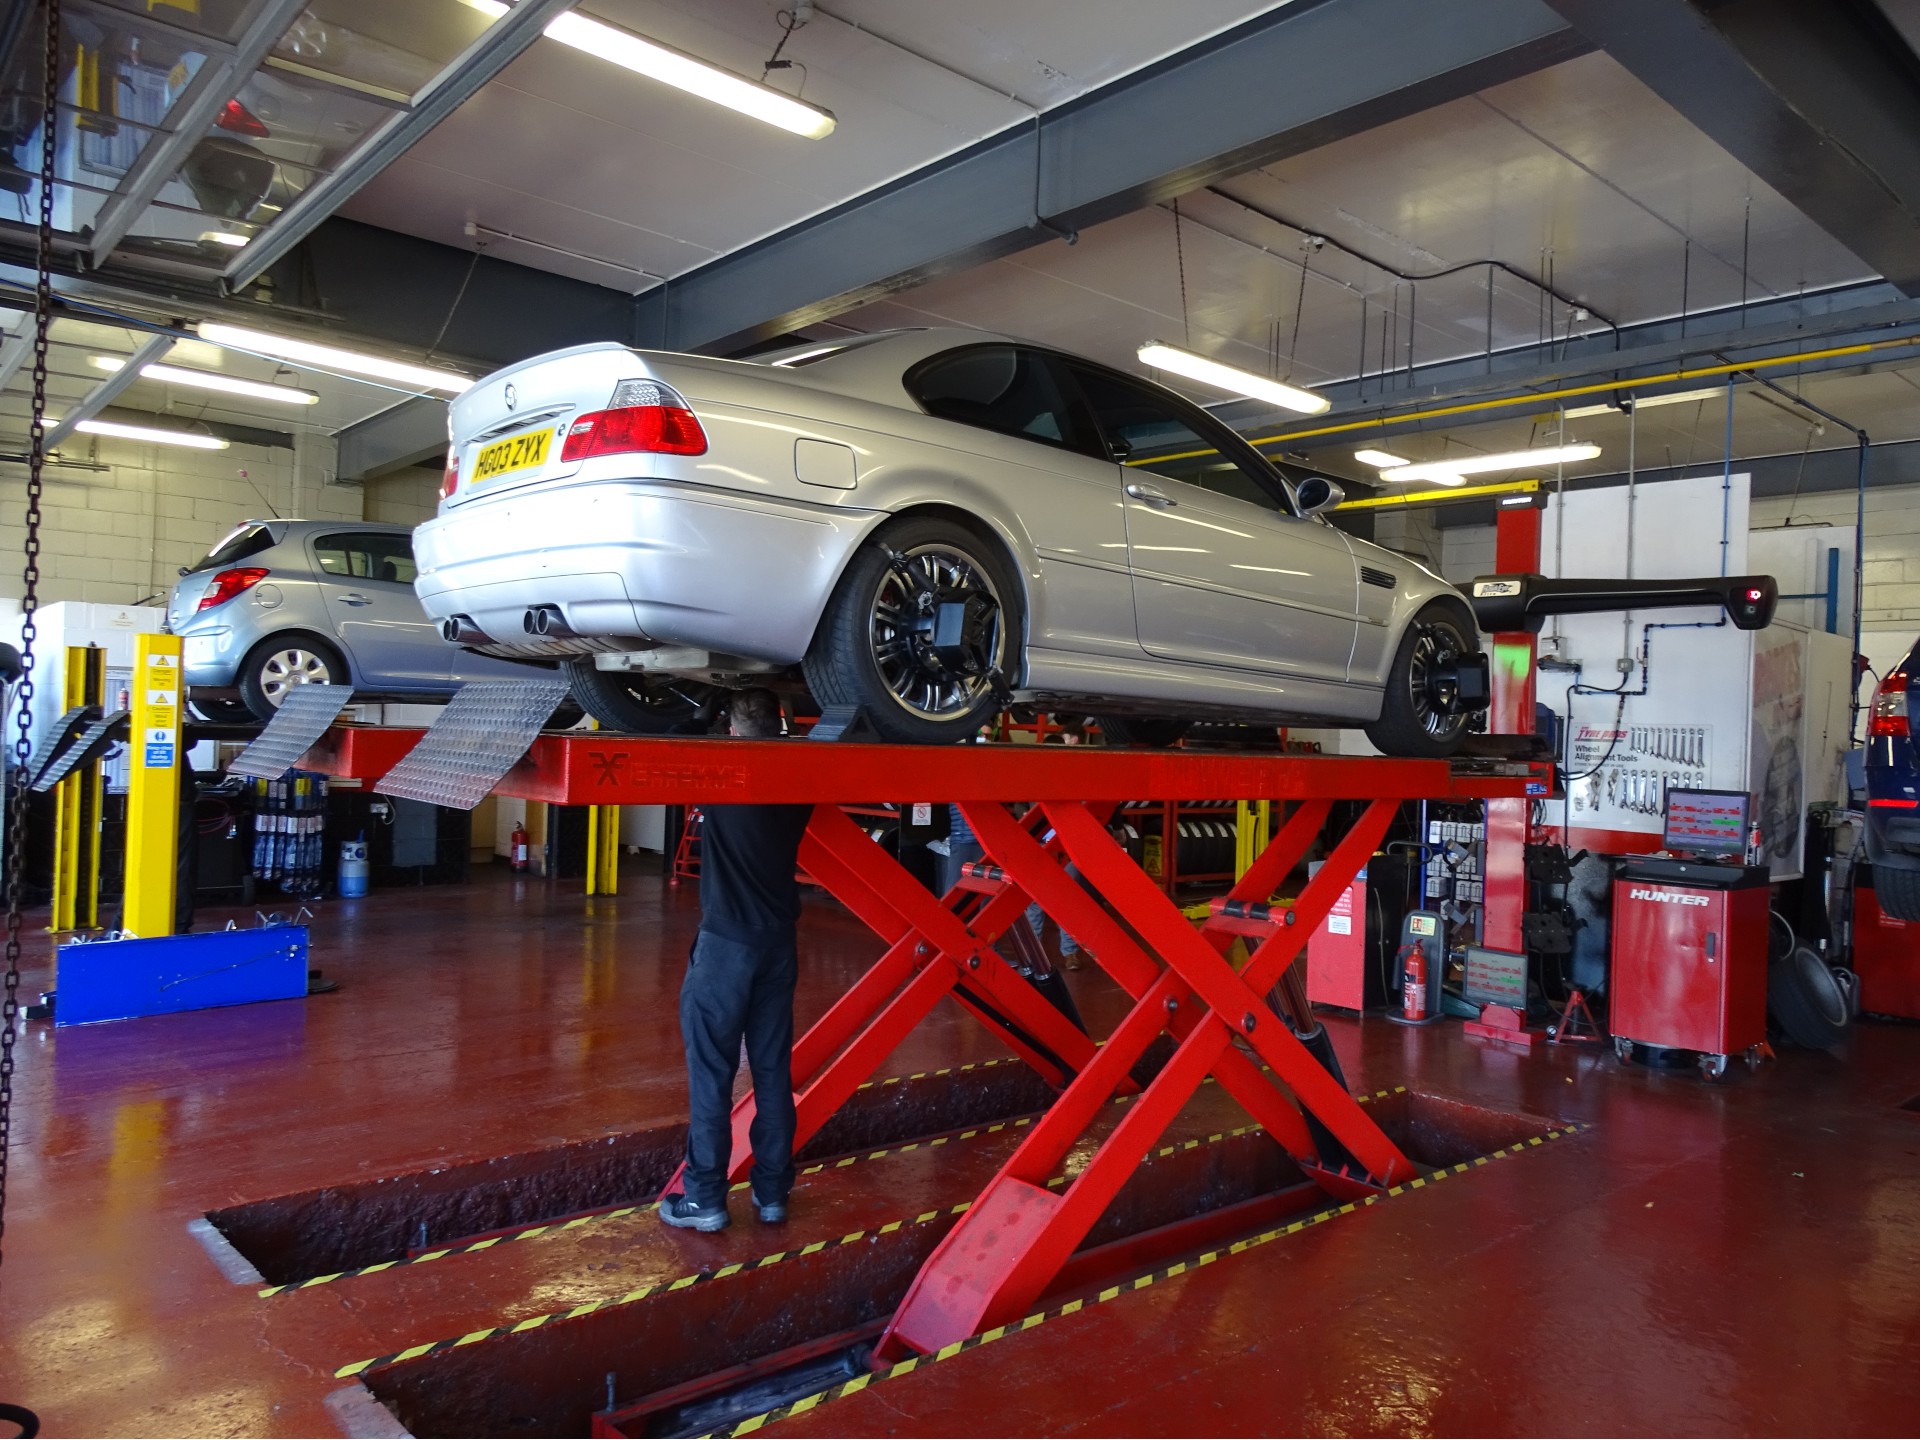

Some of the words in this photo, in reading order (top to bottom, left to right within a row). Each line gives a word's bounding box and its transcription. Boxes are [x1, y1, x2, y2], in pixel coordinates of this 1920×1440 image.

[475, 442, 512, 478] HG03
[511, 433, 547, 467] ZYX
[1575, 744, 1600, 753] Wheel
[1575, 753, 1616, 762] Alignmnt
[1617, 753, 1638, 762] Tools
[1630, 889, 1710, 907] HUNTER
